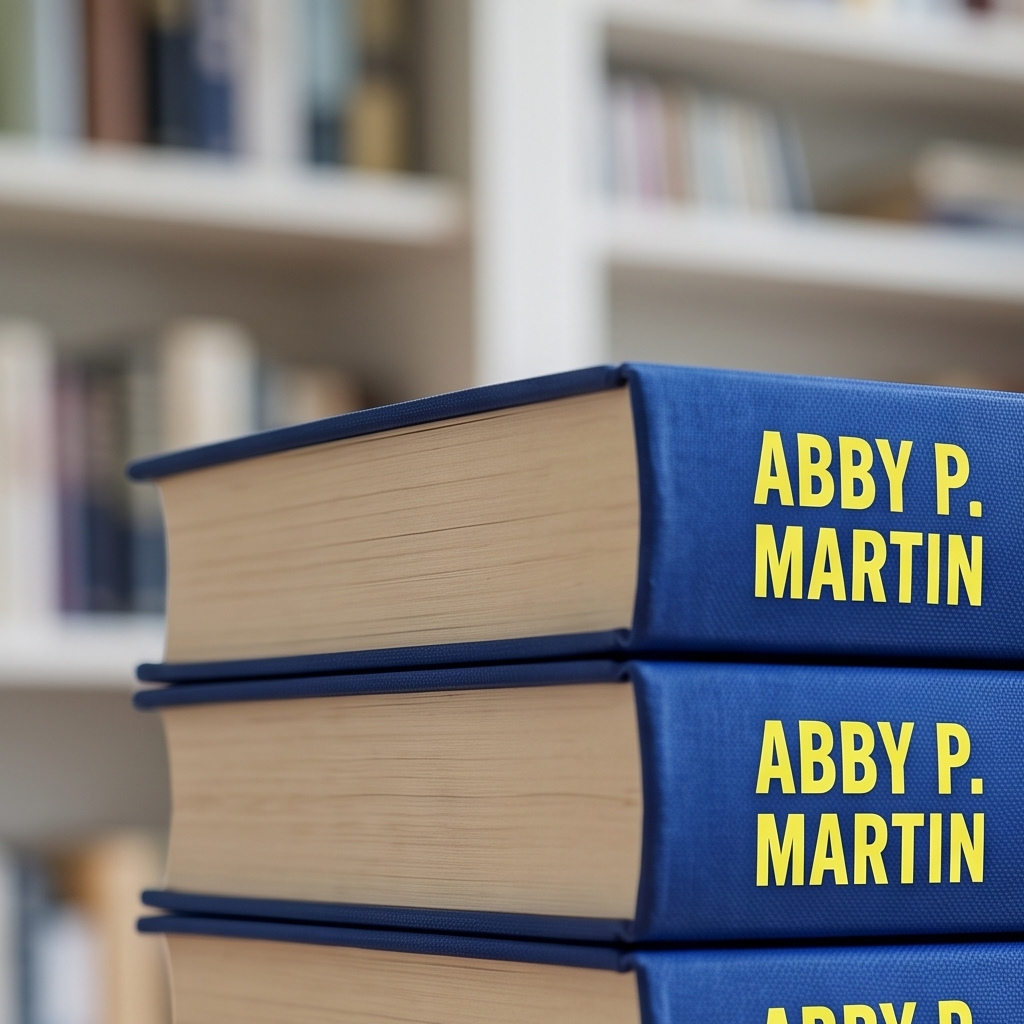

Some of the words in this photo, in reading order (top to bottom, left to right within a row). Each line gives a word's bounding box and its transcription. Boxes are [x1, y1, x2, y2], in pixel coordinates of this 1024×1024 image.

[754, 431, 913, 512] ABBY
[935, 443, 982, 517] P.
[755, 524, 982, 606] MARTIN
[756, 720, 914, 794] ABBY
[936, 723, 983, 794] P.
[757, 813, 984, 886] MARTIN
